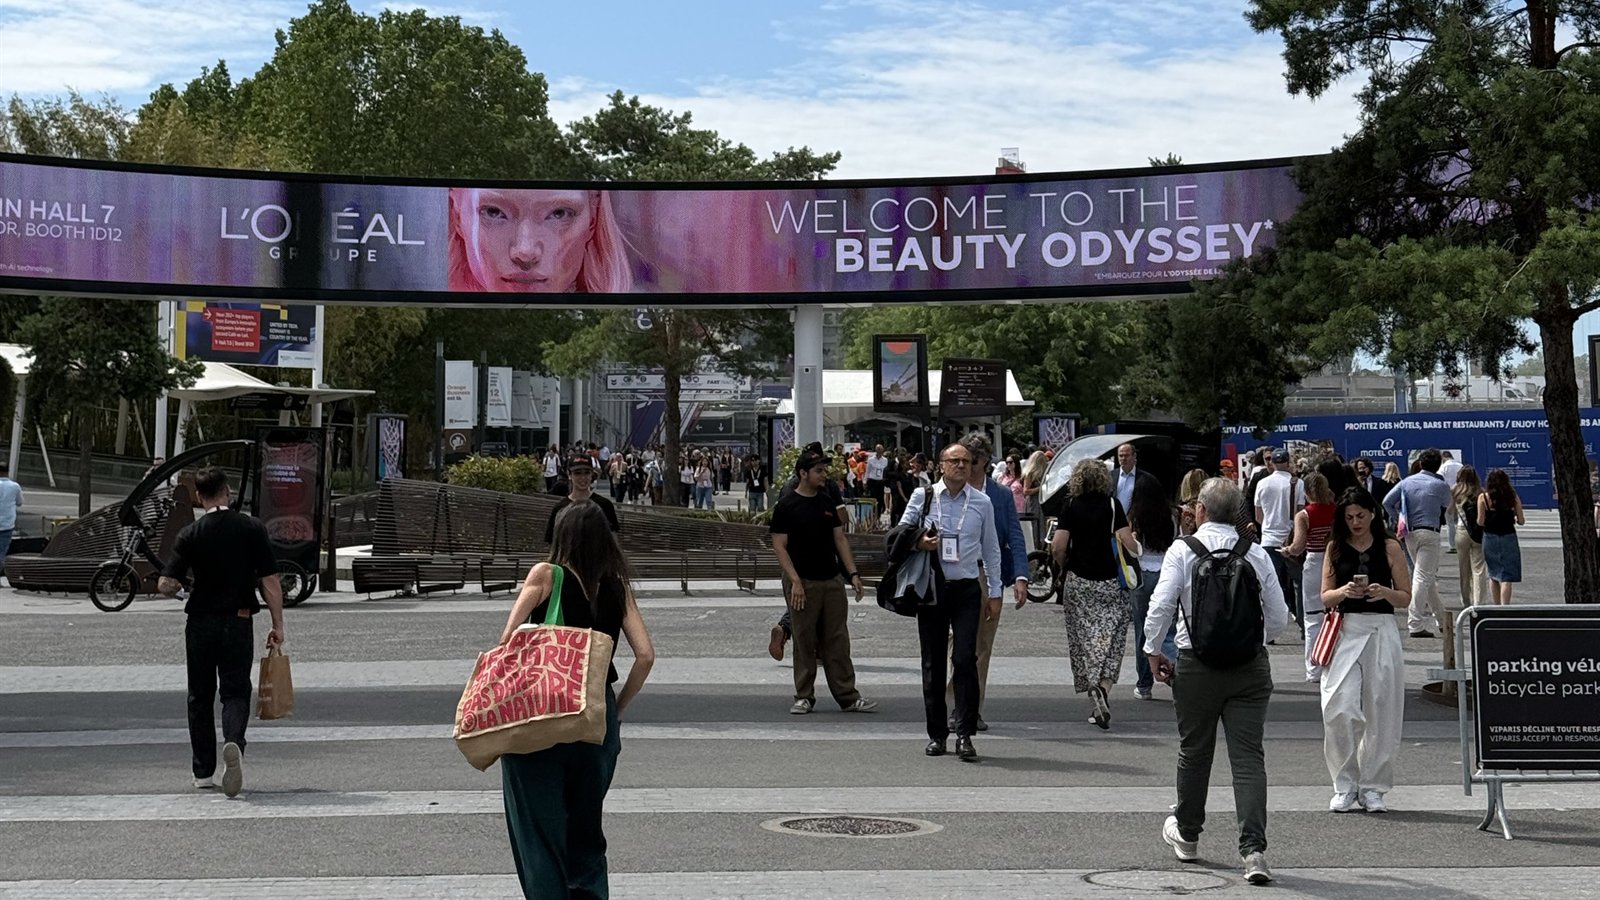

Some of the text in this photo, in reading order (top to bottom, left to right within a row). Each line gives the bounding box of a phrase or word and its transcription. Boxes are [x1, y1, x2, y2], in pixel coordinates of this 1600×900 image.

[30, 200, 95, 223] HALL
[101, 205, 115, 224] 7
[765, 185, 1198, 234] WELCOME TO THE
[25, 223, 85, 240] BOOTH
[90, 227, 122, 241] 1D12
[221, 204, 425, 245] L'OÉAL
[269, 246, 377, 262] GRUPE
[836, 233, 1026, 272] BEAUTY
[17, 264, 53, 274] technology
[1142, 270, 1163, 279] POUR
[489, 389, 500, 397] 12
[1288, 424, 1308, 433] VISIT
[1345, 422, 1378, 430] PROFITEZ
[1379, 422, 1392, 430] DES
[1423, 421, 1442, 429] BARS
[1443, 421, 1452, 429] ET
[1452, 420, 1504, 429] RESTAURANTS
[1511, 420, 1536, 428] ENJOY
[553, 629, 588, 650] VU
[543, 645, 585, 684] RUE
[1487, 657, 1562, 675] parking
[463, 668, 543, 713] PAS DANS
[1488, 680, 1556, 697] bicycle
[478, 670, 583, 729] LA NATURE
[1522, 725, 1556, 733] DÉCLINE
